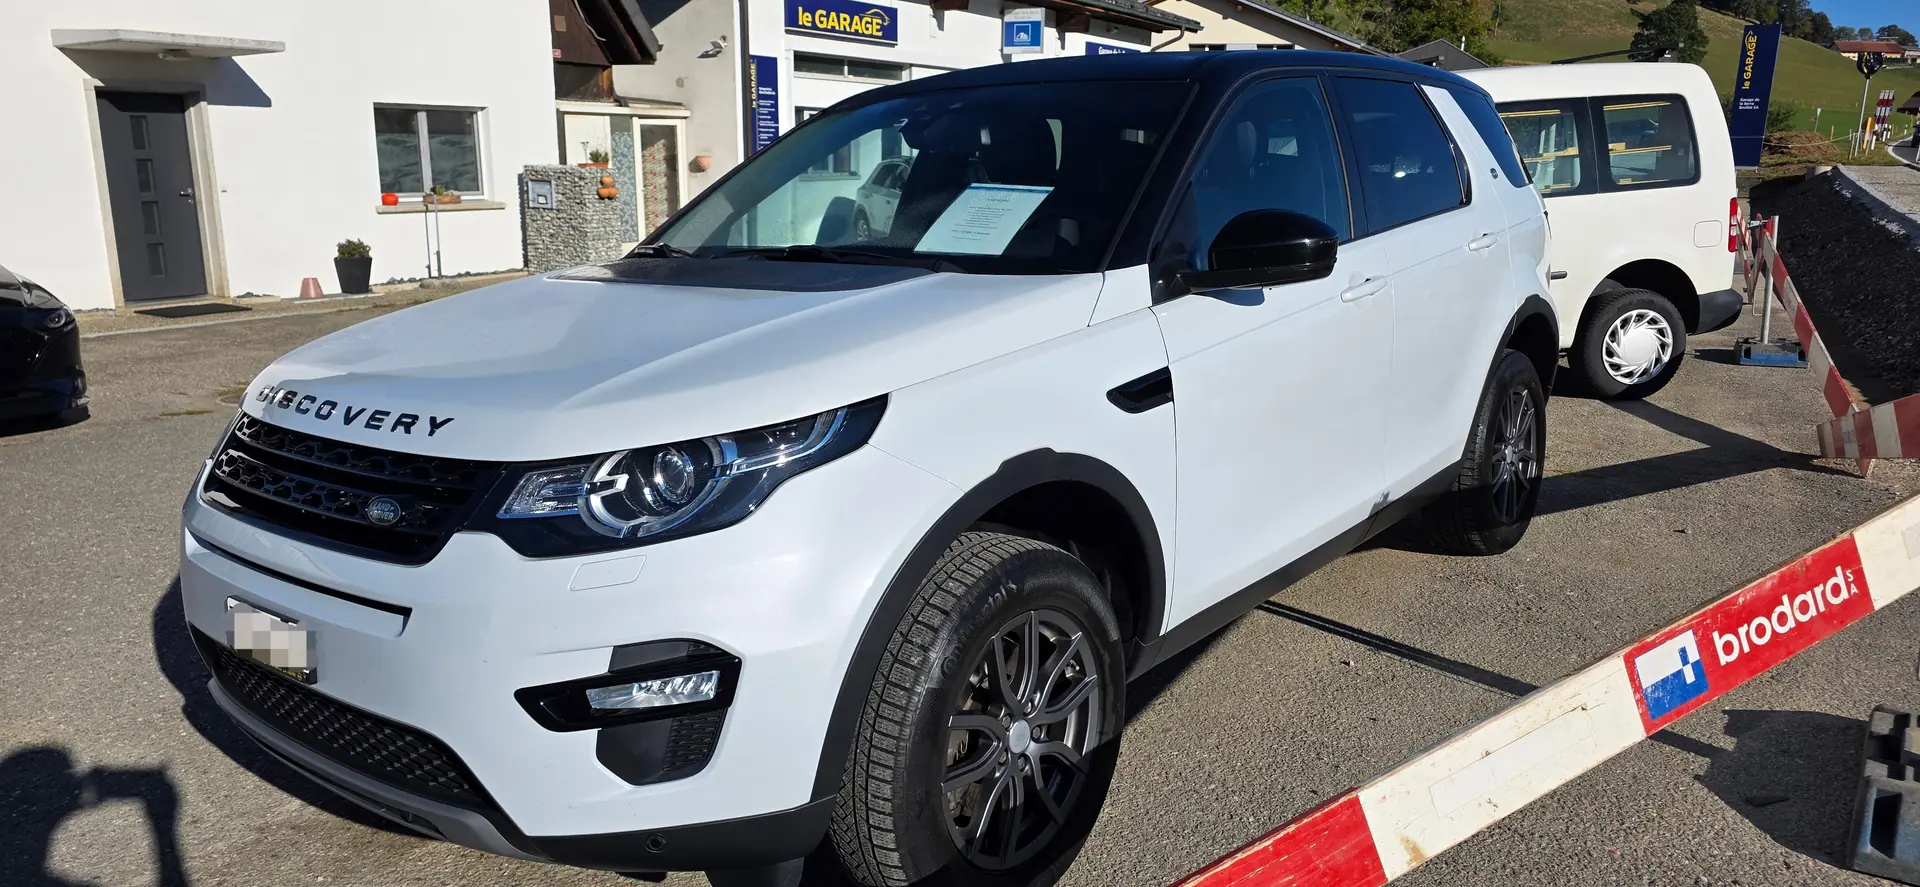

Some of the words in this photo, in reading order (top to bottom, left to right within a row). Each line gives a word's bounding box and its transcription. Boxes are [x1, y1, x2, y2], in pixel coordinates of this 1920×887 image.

[798, 6, 812, 27] le
[815, 9, 883, 36] GARAGE
[1743, 35, 1758, 80] GARAGE
[1741, 81, 1751, 90] le
[255, 384, 455, 437] DISCOVERY
[371, 510, 395, 521] ROVER
[372, 502, 391, 511] LAND
[1712, 565, 1850, 666] brodard
